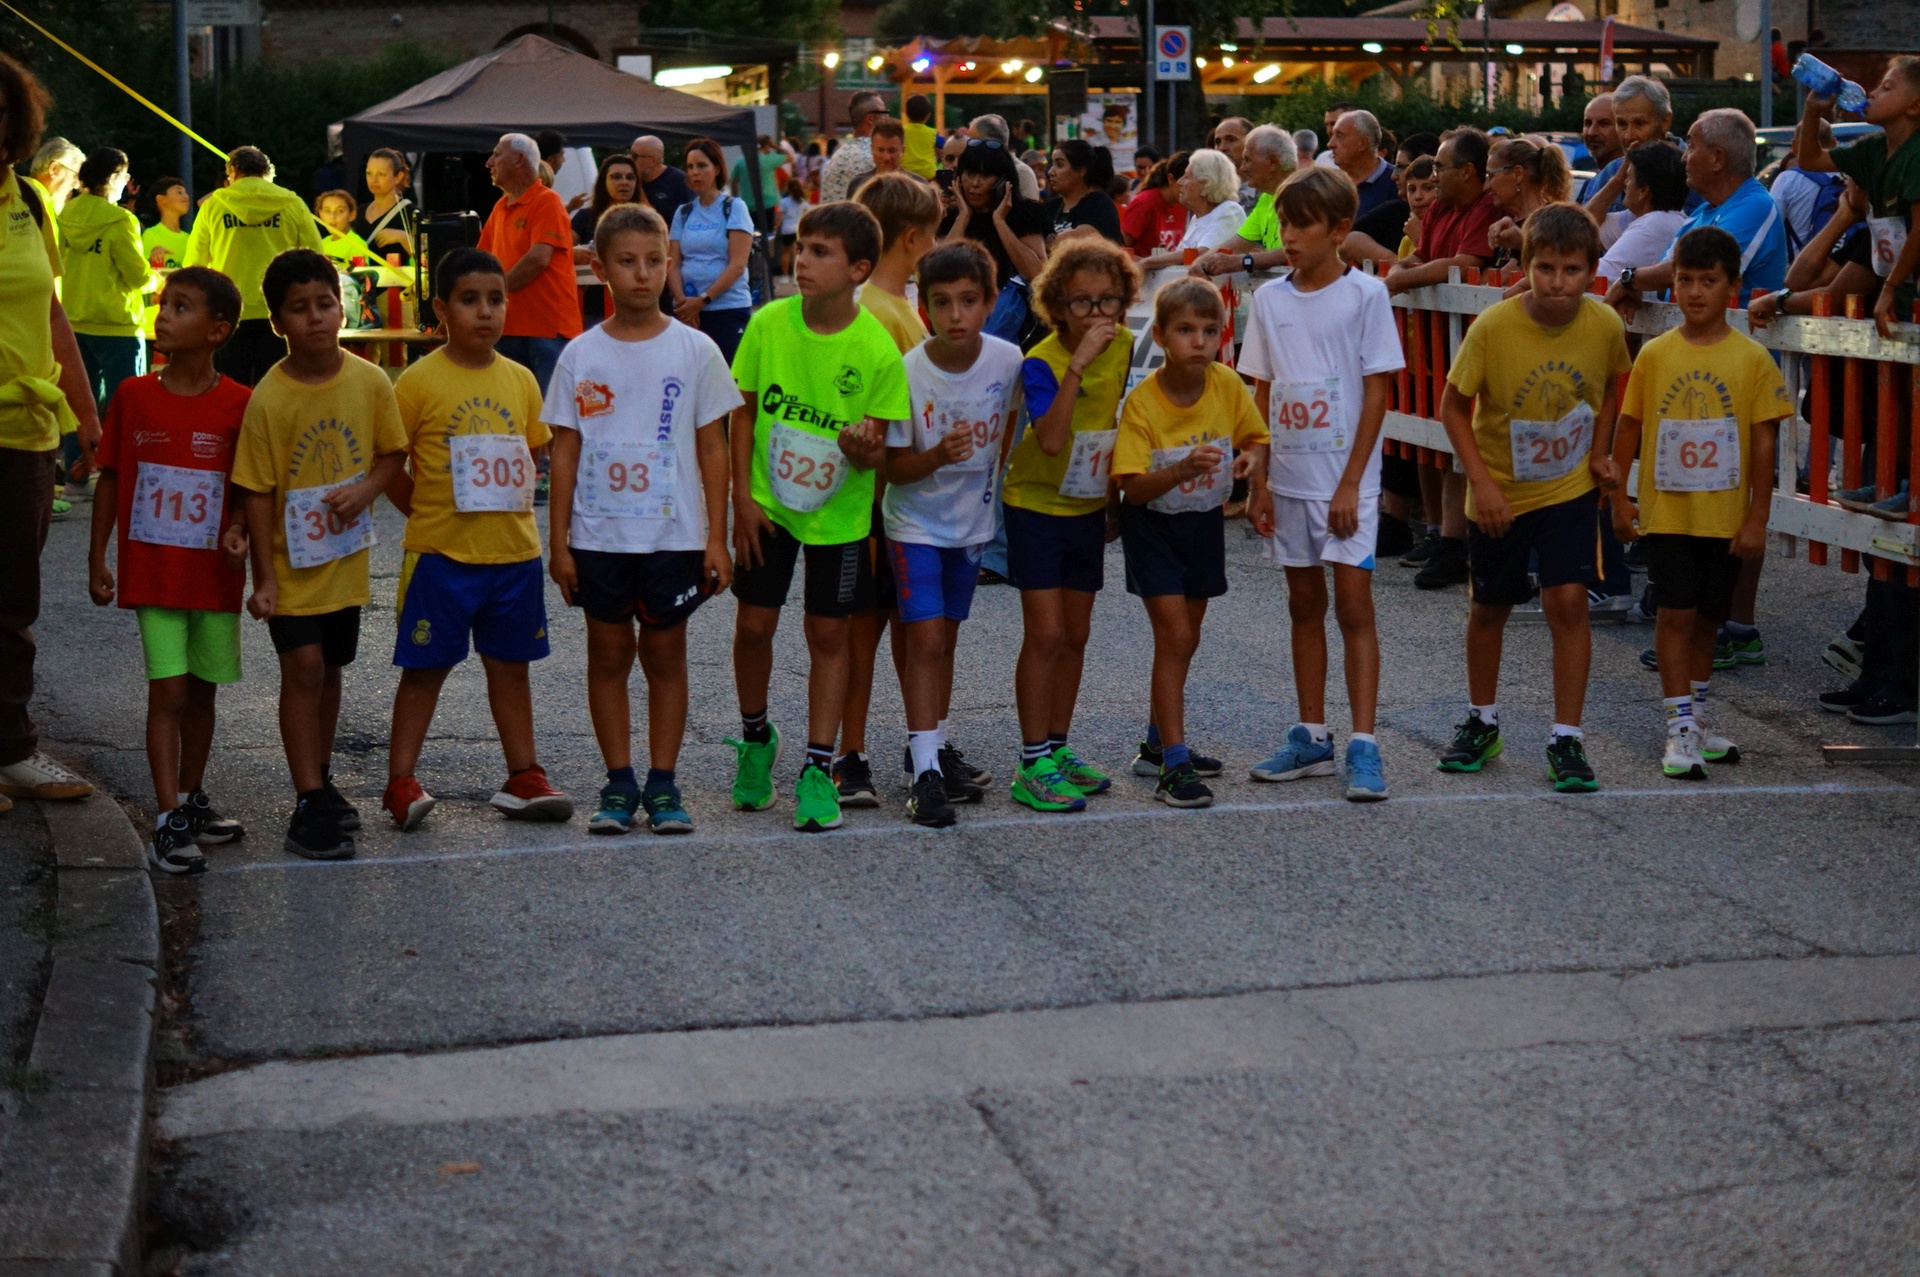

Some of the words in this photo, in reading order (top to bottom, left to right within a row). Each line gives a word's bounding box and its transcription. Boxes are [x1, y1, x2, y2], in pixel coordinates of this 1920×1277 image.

[952, 413, 1000, 449] 92
[1279, 400, 1331, 430] 492
[1530, 425, 1584, 464] 207
[1680, 440, 1719, 469] 62
[471, 457, 526, 488] 303
[608, 462, 650, 493] 93
[777, 449, 836, 491] 523
[150, 487, 207, 524] 113
